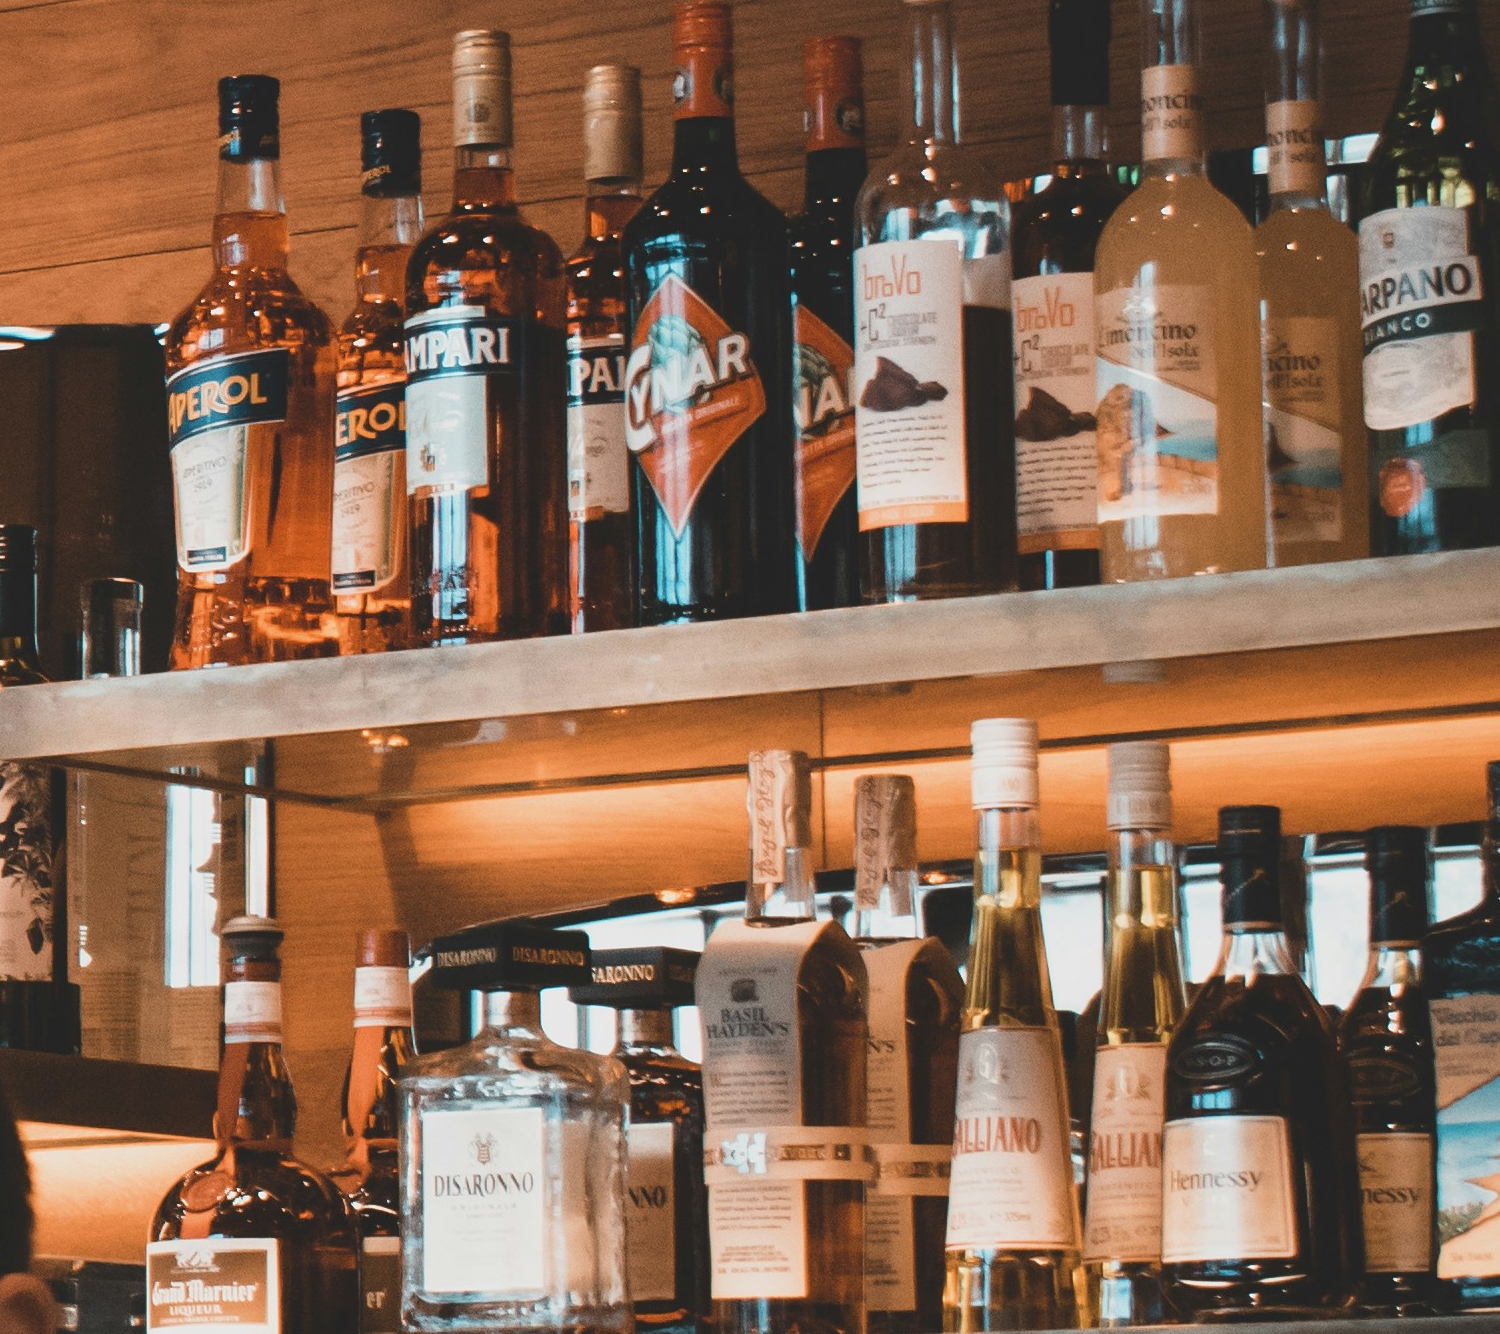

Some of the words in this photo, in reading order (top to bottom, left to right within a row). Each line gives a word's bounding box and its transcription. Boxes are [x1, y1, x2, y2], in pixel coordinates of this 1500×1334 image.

[168, 372, 268, 434] APEROL
[625, 331, 751, 453] CYNAR
[436, 946, 498, 968] DISARONNO
[512, 945, 585, 967] DISARONNO
[434, 1170, 534, 1198] DISARONNO
[1170, 1170, 1263, 1192] Hennessy
